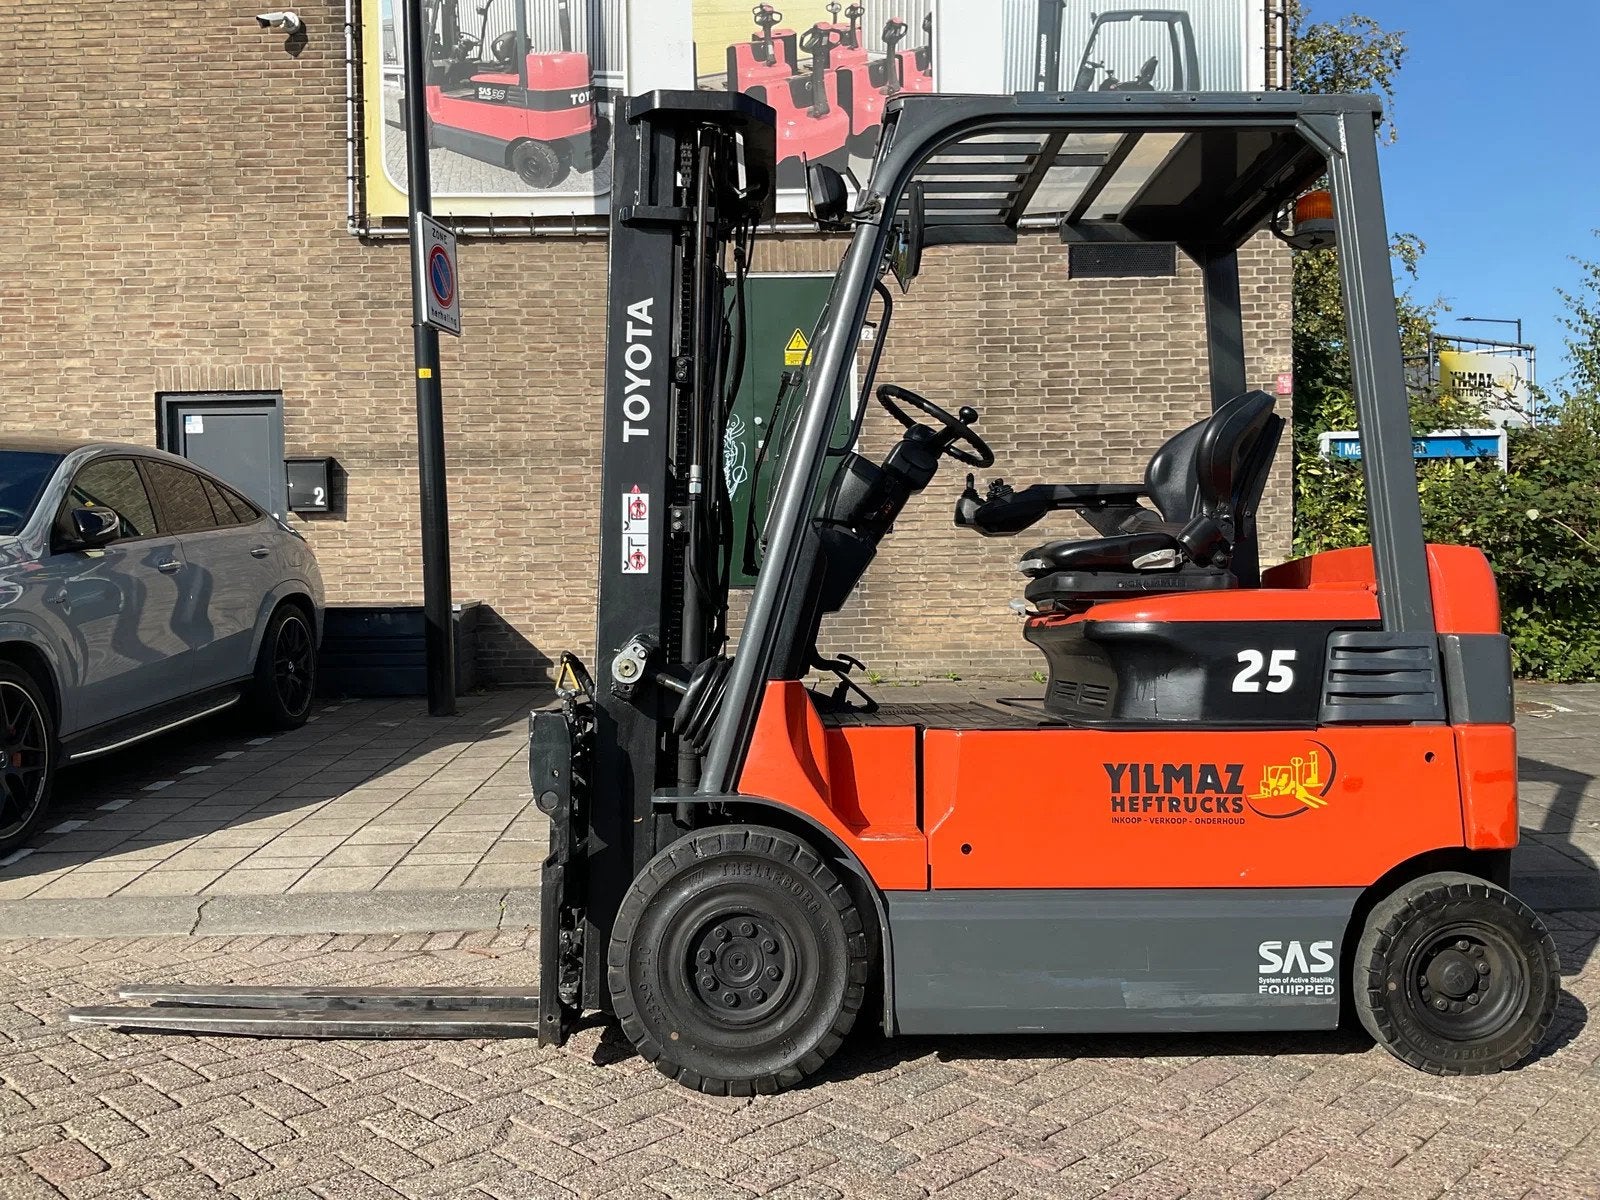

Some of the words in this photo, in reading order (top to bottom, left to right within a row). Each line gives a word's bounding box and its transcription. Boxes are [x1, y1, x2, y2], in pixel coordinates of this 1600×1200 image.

[431, 227, 448, 245] ZONE
[431, 305, 458, 329] herhaling
[622, 297, 654, 443] TOYOTA
[313, 486, 325, 506] 2
[1231, 649, 1297, 693] 25
[1103, 763, 1244, 794] YILMAZ
[1111, 796, 1244, 813] HEFTRUCKS
[1149, 817, 1188, 825] VERKOOP
[1258, 940, 1335, 974] SAS
[1258, 976, 1282, 985] System
[1282, 976, 1289, 984] of
[1289, 976, 1309, 984] Active
[1309, 976, 1335, 985] Stability
